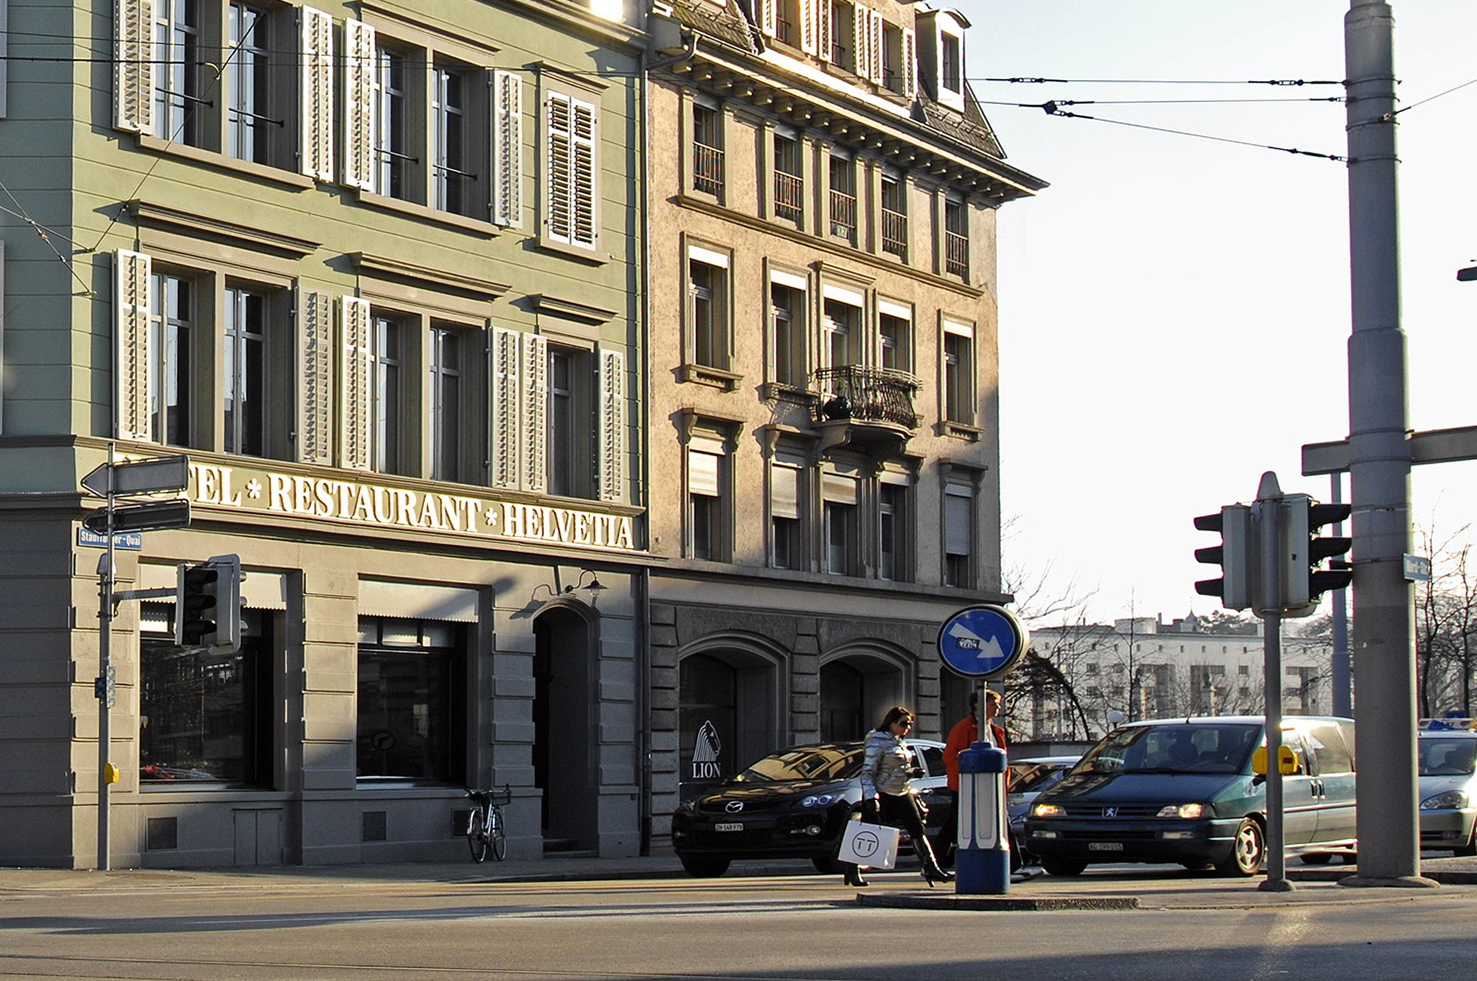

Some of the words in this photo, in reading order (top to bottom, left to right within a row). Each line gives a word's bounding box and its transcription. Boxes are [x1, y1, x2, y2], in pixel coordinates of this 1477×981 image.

[266, 473, 482, 532] RESTAURANT
[500, 503, 635, 549] HELVETIA
[692, 762, 721, 779] LION
